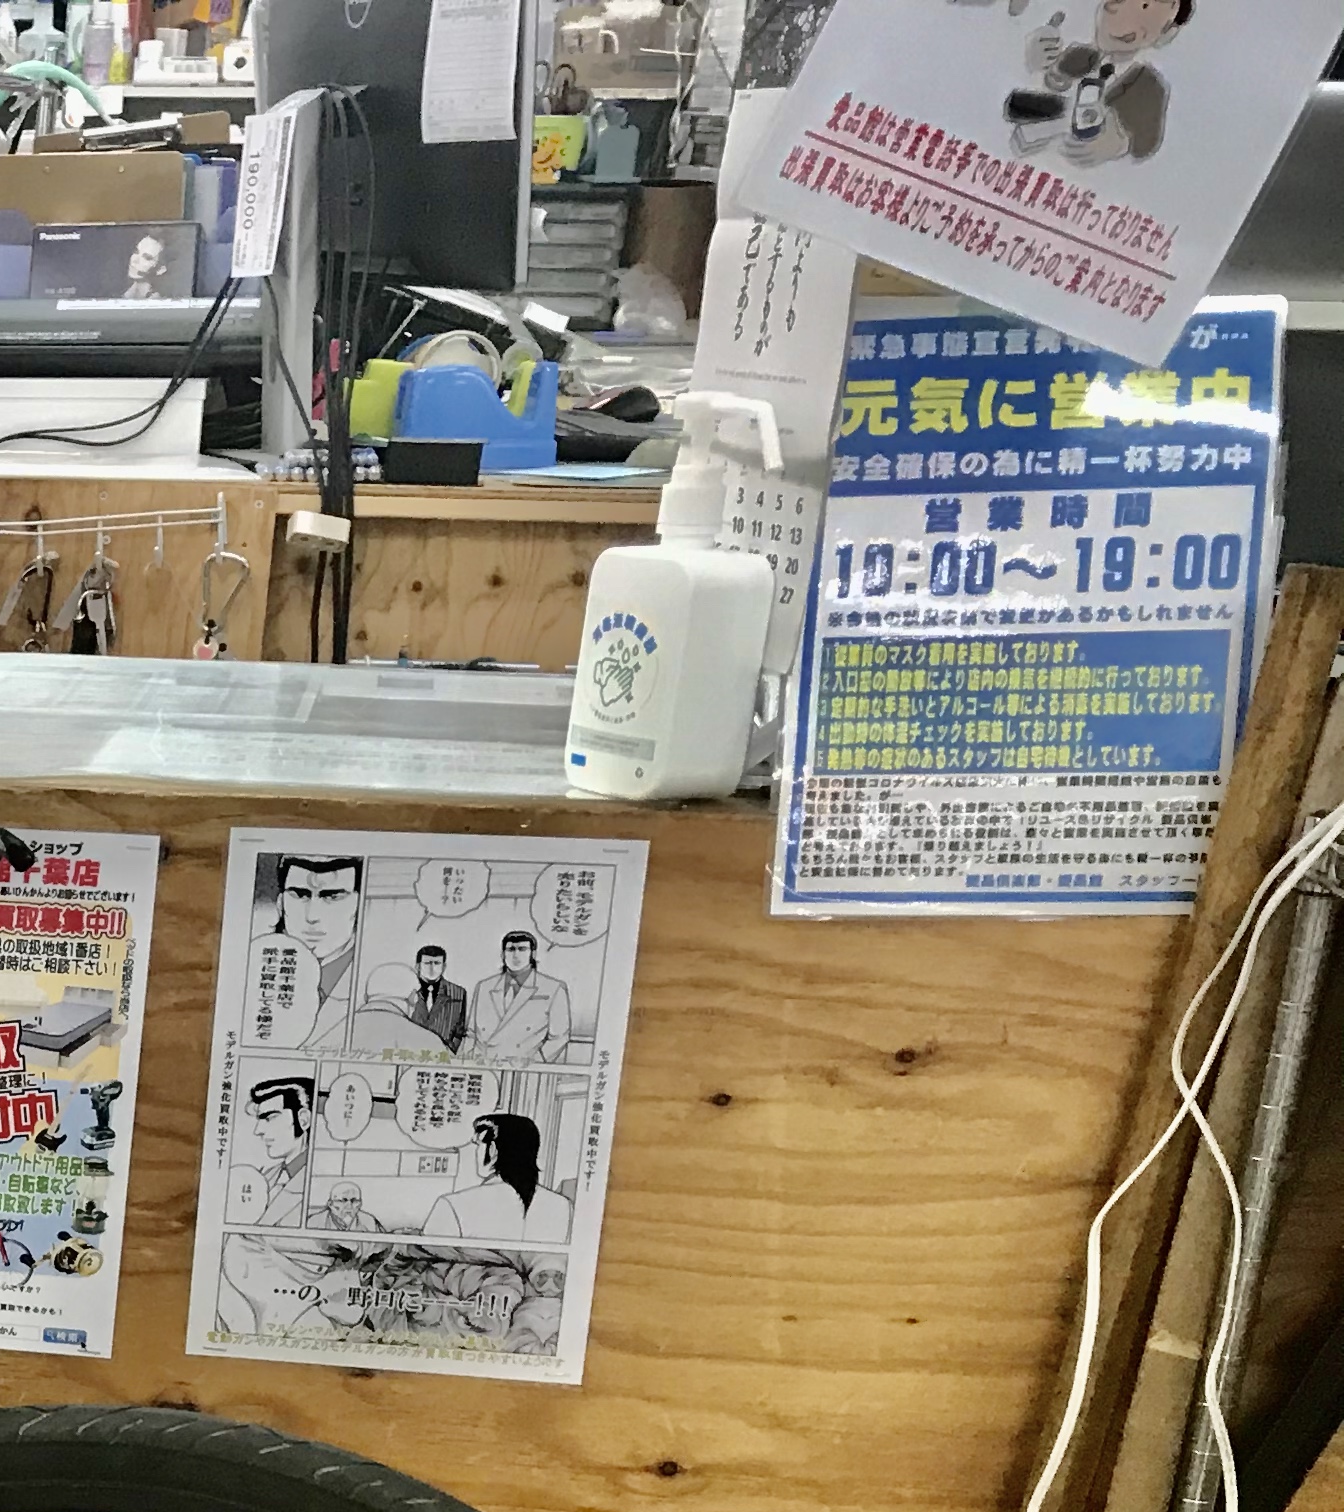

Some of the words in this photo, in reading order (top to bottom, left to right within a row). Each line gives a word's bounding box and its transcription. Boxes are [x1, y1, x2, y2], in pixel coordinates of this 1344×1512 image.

[736, 487, 744, 505] 3
[755, 491, 764, 508] 4
[775, 494, 783, 511] 5
[795, 496, 804, 514] 6
[924, 493, 1154, 533] 営業時間
[732, 516, 744, 534] 10
[751, 519, 762, 538] 11
[770, 522, 782, 541] 12
[789, 526, 803, 545] 13
[785, 556, 799, 576] 20
[779, 586, 794, 604] 27
[30, 840, 85, 856] ショップ
[217, 1030, 237, 1170] モデルガン強化買取中です！
[584, 1049, 611, 1193] モデルガン強化買取中です！
[240, 1183, 253, 1204] はい
